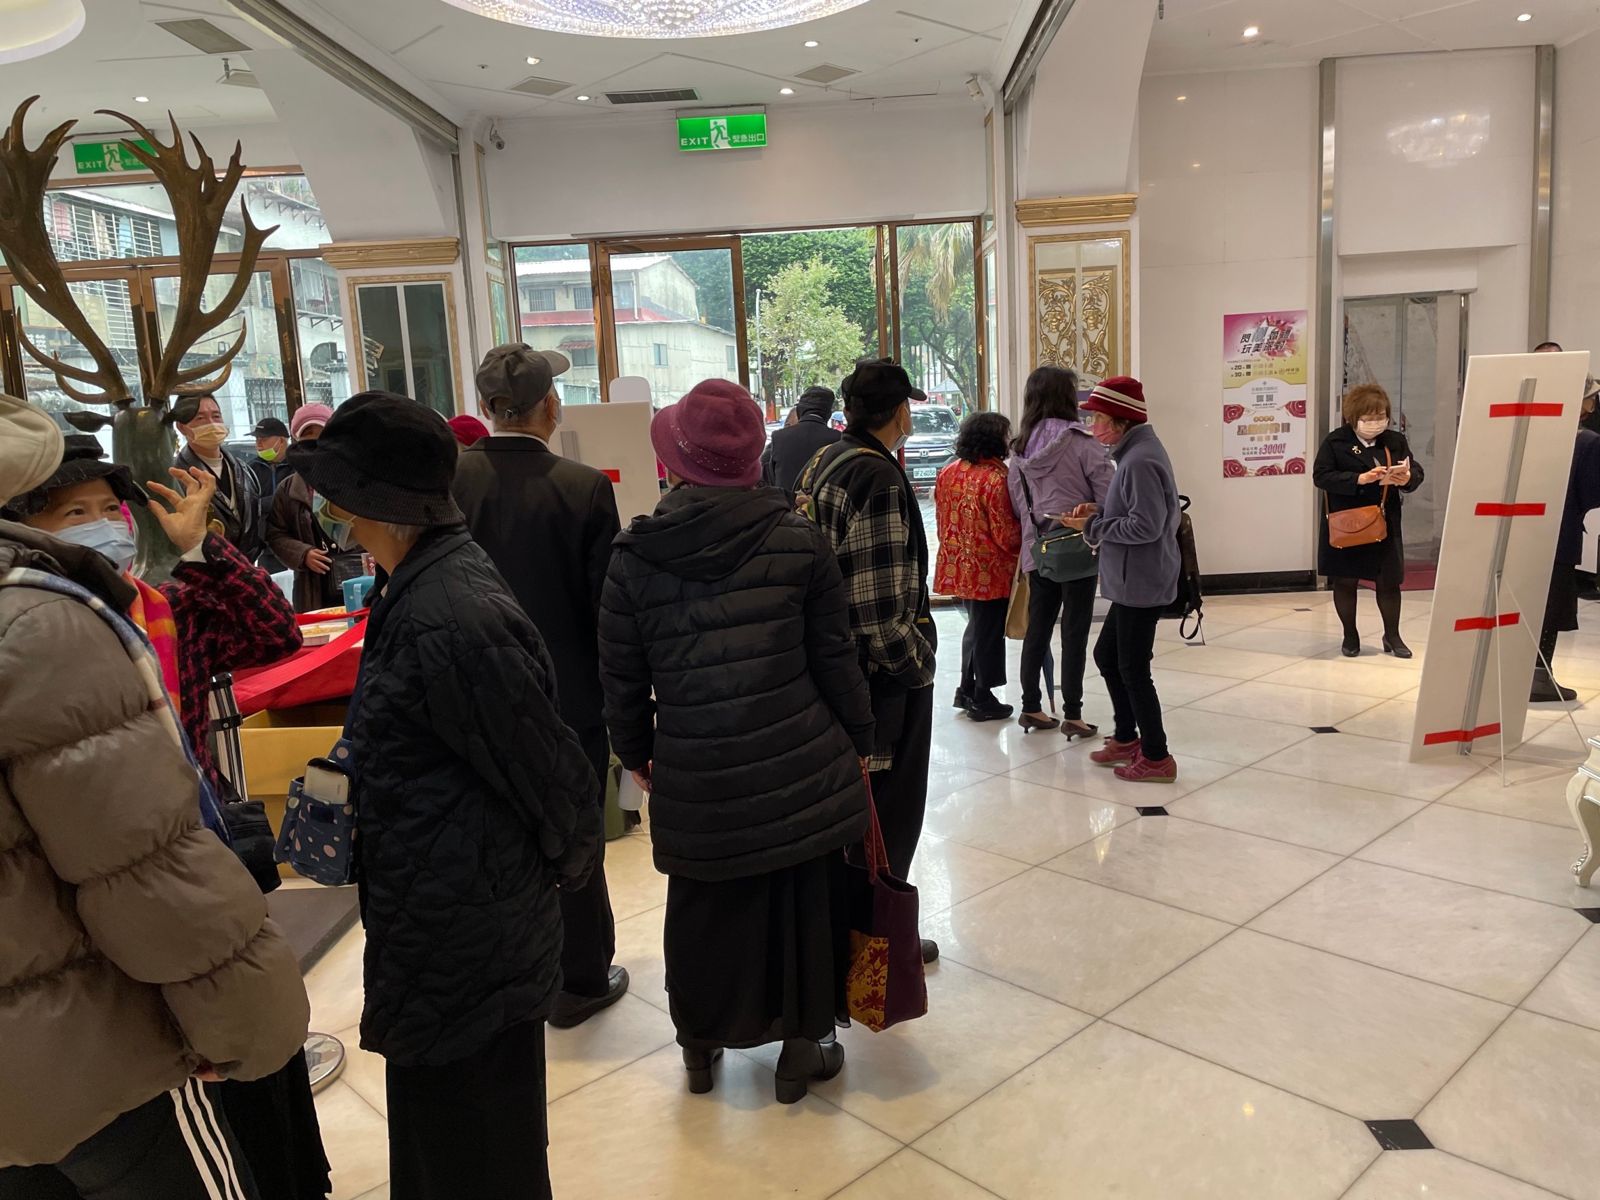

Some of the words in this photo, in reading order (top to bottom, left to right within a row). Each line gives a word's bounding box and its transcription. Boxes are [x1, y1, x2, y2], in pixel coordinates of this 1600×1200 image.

[680, 136, 709, 146] EXIT
[732, 133, 765, 143] 緊急出口
[77, 160, 103, 169] EXIT
